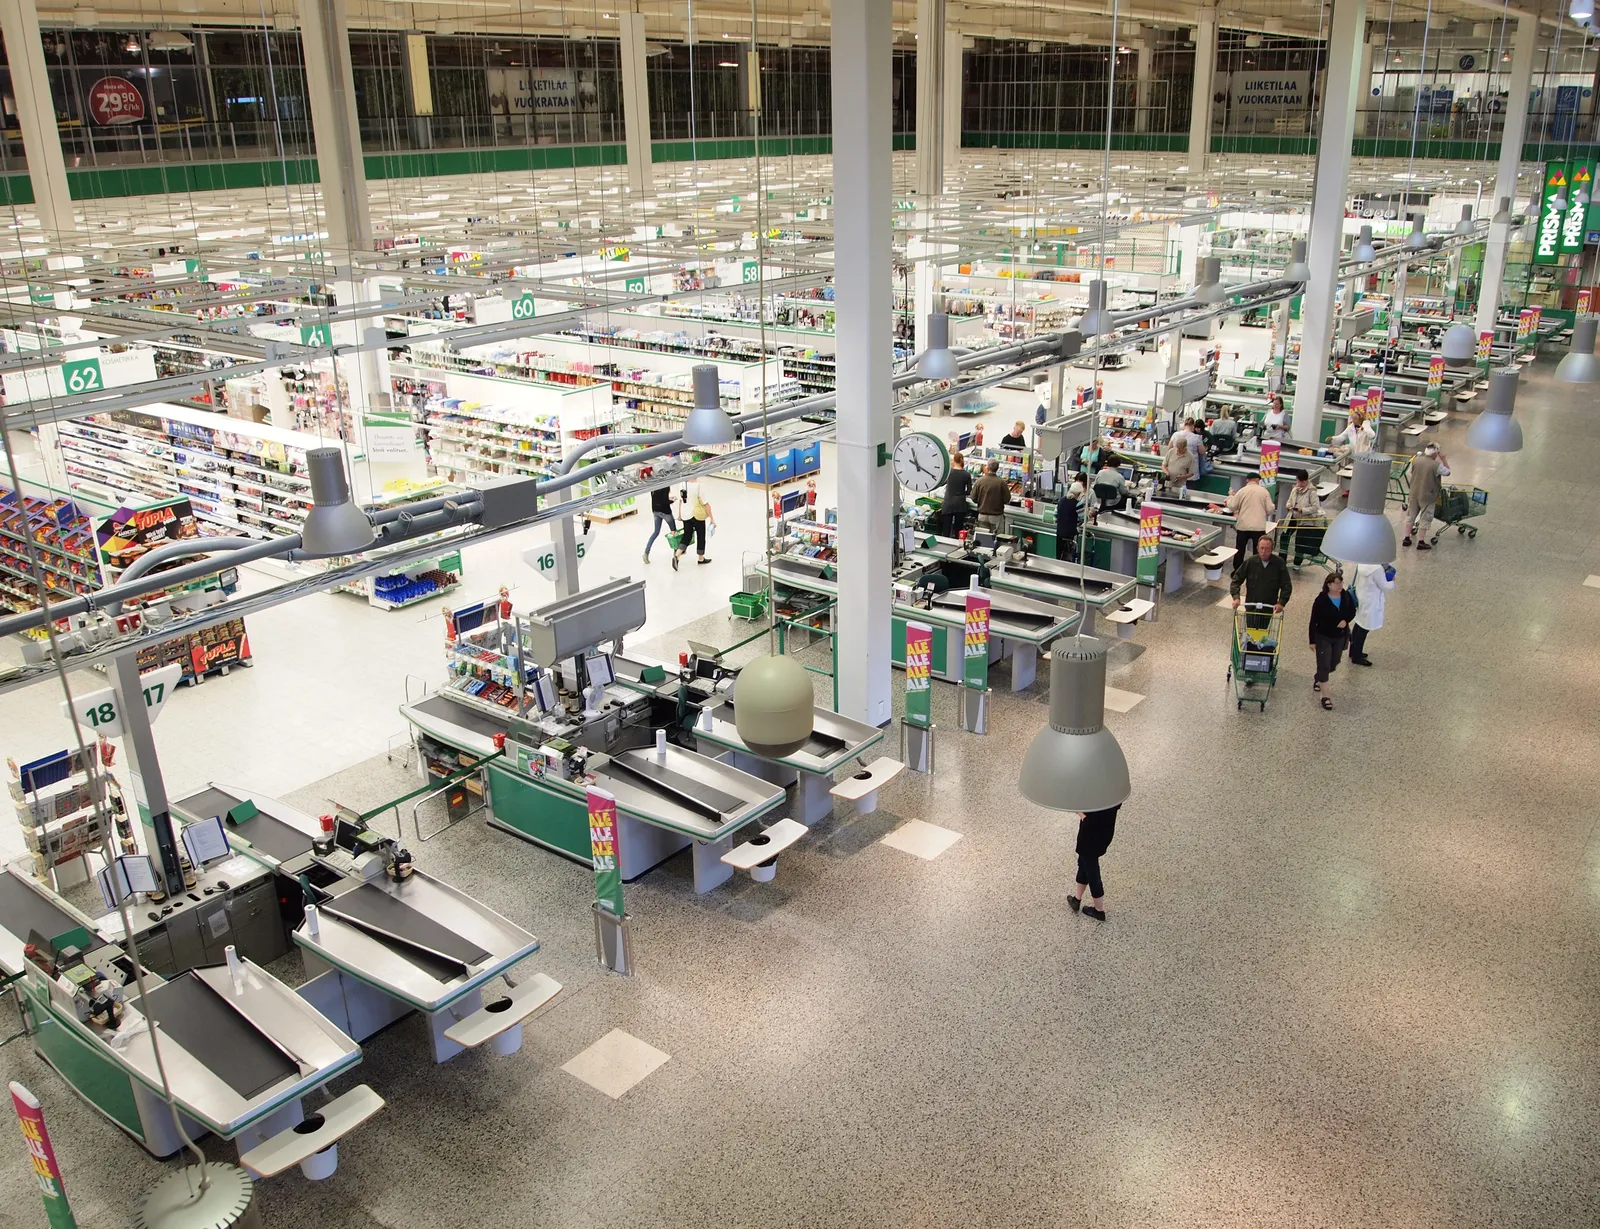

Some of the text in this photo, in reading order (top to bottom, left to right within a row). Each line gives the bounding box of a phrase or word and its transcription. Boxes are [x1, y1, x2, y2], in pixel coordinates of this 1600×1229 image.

[1245, 81, 1297, 91] LIIKETILAA
[1237, 95, 1303, 105] VUOKRATAAN
[744, 267, 758, 283] 58
[513, 299, 534, 318] 60
[308, 326, 325, 347] 61
[69, 366, 100, 392] 62
[1260, 451, 1279, 464] ALE
[1259, 460, 1278, 472] ALE
[1260, 469, 1277, 479] ALE
[137, 507, 175, 530] TUPLA
[1140, 517, 1161, 529] ALE
[1140, 526, 1160, 538] ALE
[1139, 536, 1159, 548] ALE
[1138, 545, 1159, 557] ALE
[537, 553, 555, 571] 16
[965, 609, 989, 624] ALE
[965, 621, 988, 635] ALE
[965, 632, 988, 646] ALE
[199, 639, 236, 665] TUPLA
[906, 641, 931, 656] ALE
[964, 643, 987, 657] ALE
[906, 653, 931, 667] ALE
[906, 665, 930, 679] ALE
[906, 677, 930, 691] ALE
[142, 682, 165, 707] 17
[86, 702, 117, 727] 18
[588, 812, 614, 828] ALE
[590, 827, 614, 842] ALE
[591, 841, 615, 857] ALE
[592, 855, 616, 870] ALE
